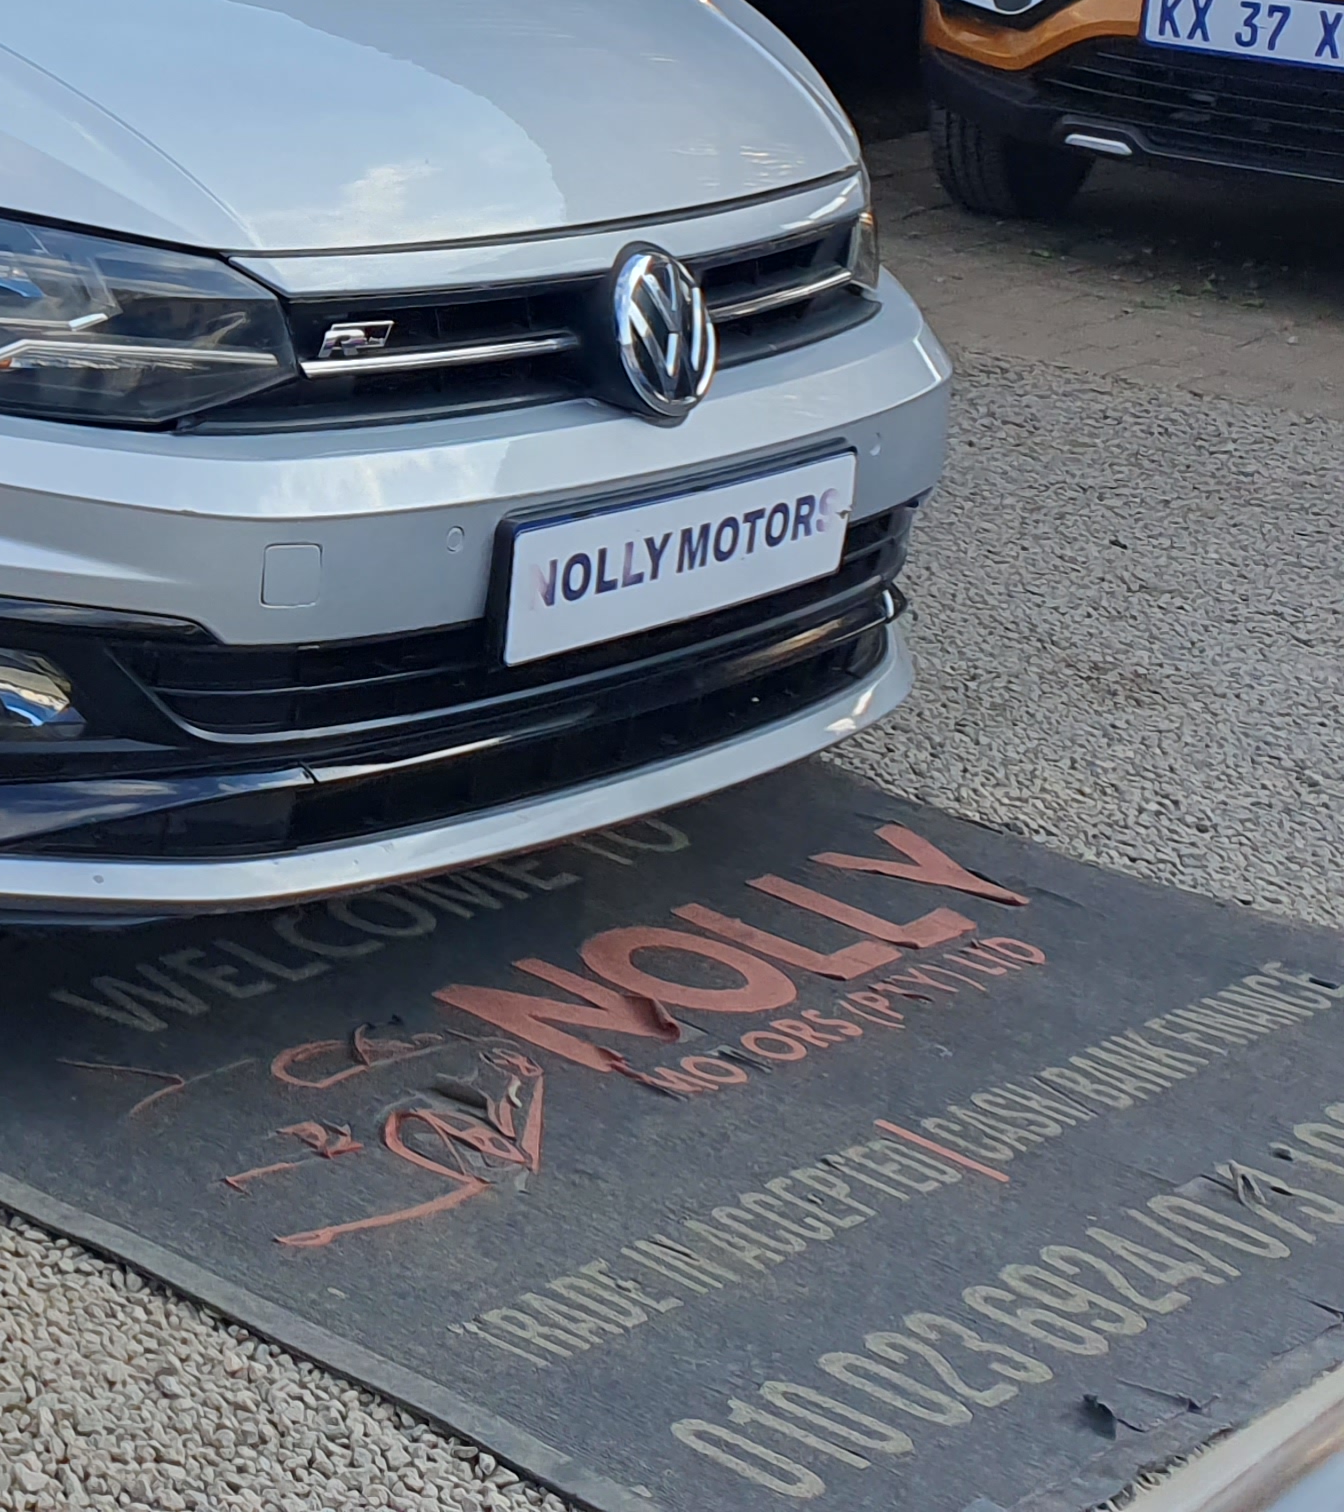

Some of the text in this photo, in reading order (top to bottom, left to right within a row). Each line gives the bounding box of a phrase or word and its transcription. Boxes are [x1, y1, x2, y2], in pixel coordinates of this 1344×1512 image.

[1234, 1, 1292, 51] 37
[1314, 10, 1344, 59] X
[675, 488, 840, 574] MOTORS
[51, 858, 583, 1032] WELCOME
[432, 823, 1030, 1073] NOLLY
[448, 1257, 685, 1368] TRADE
[621, 1233, 740, 1294] IN
[682, 1137, 962, 1273] ACCEPTED
[921, 1028, 1210, 1161] CASH/BANK
[1143, 961, 1344, 1056] FINANCE
[670, 1381, 916, 1498] 010
[818, 1312, 1054, 1427] 023
